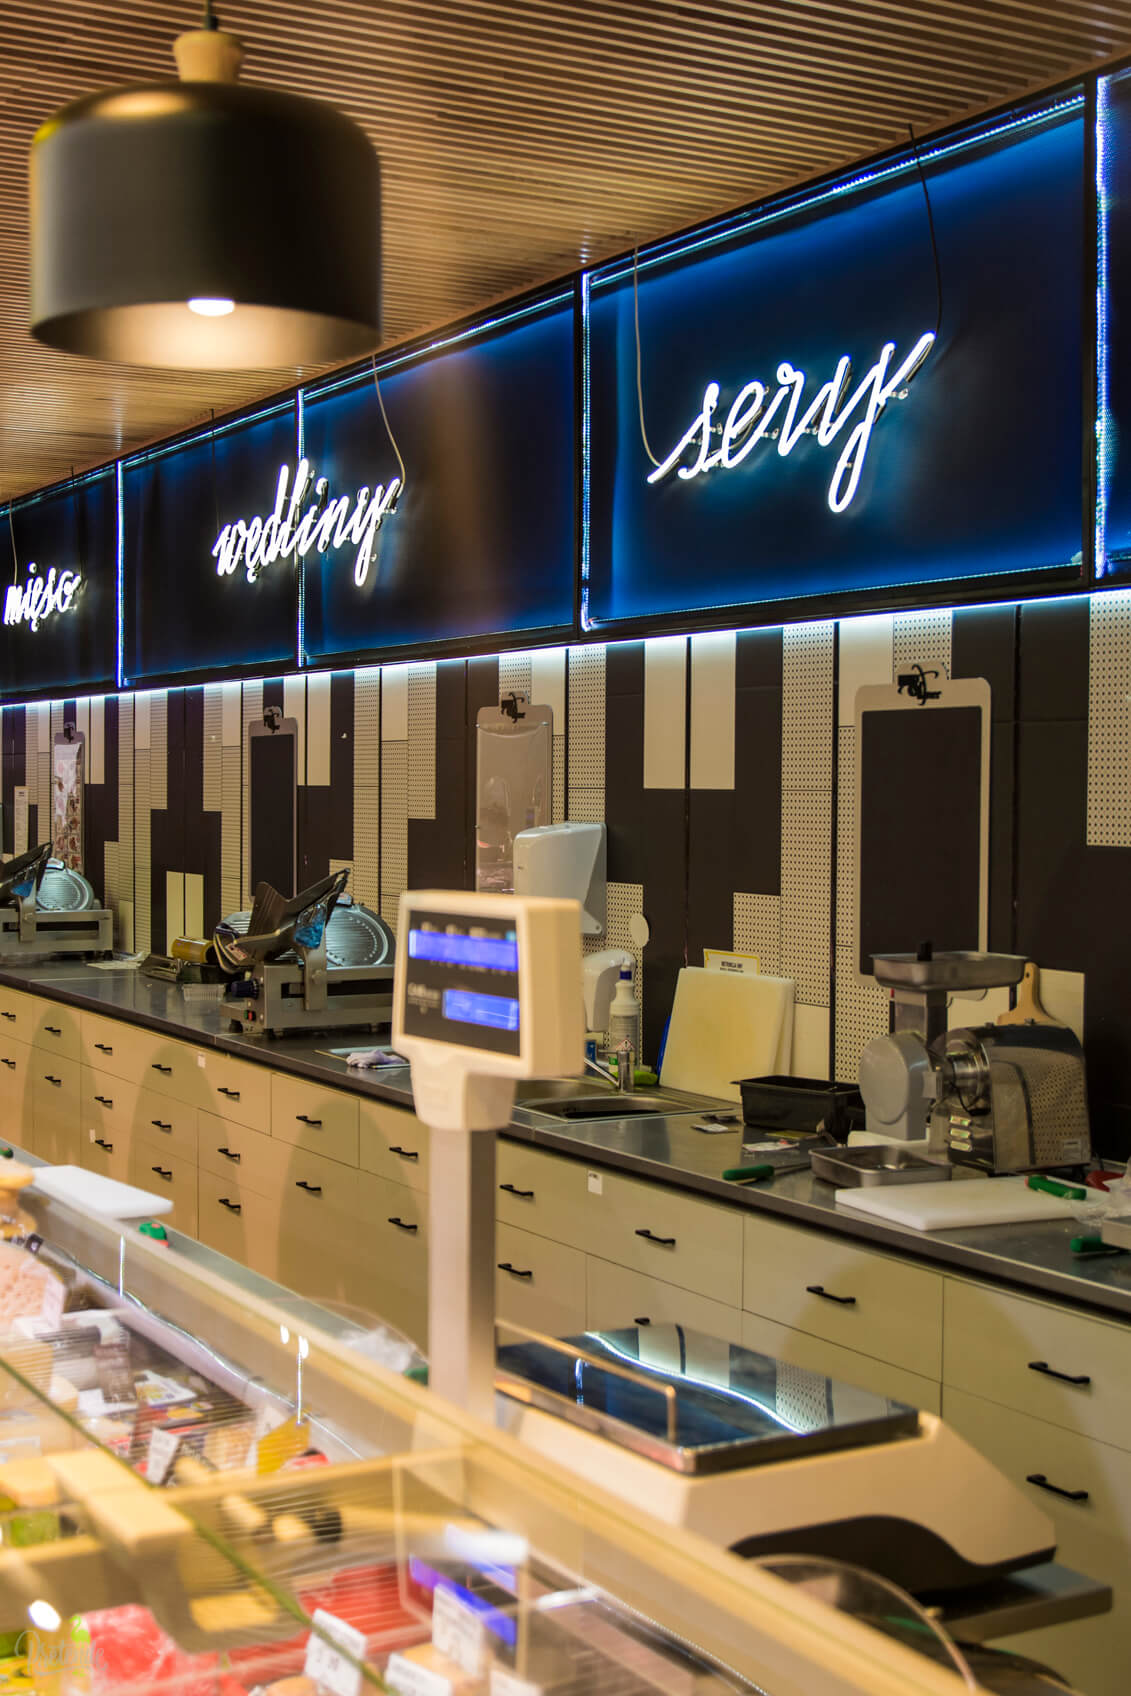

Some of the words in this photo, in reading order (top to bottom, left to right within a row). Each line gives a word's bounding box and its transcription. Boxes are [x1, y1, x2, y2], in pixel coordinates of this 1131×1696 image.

[647, 332, 936, 512] sery
[211, 457, 400, 586] wędliny
[3, 561, 82, 632] mięso
